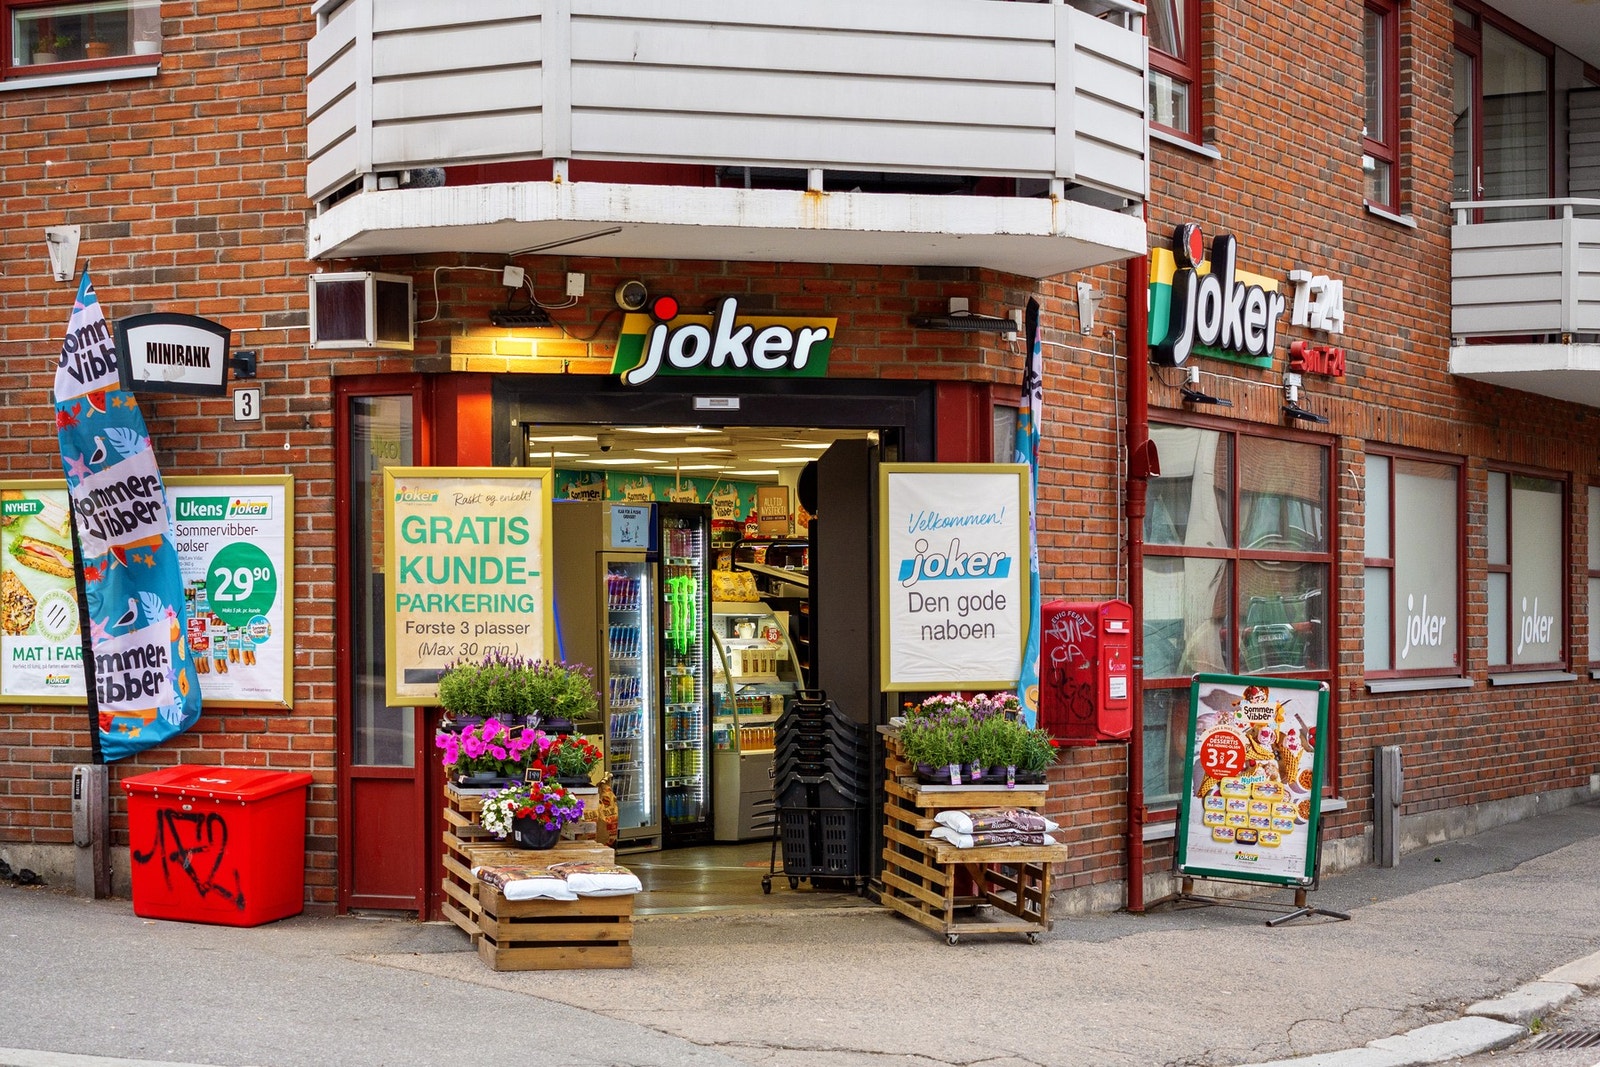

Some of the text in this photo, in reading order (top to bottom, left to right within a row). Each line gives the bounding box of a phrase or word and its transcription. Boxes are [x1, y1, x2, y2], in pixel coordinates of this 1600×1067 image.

[1173, 223, 1286, 367] joker
[625, 295, 830, 386] joker
[146, 341, 211, 368] MINIBANK
[242, 392, 252, 416] 3
[395, 486, 438, 504] joker
[453, 490, 532, 506] Raskt og enkelt!
[5, 502, 37, 512] NYHET!
[180, 499, 267, 518] Ukens joker
[176, 523, 259, 536] Sommervibber-
[401, 515, 530, 545] GRATIS
[908, 506, 1006, 534] Velkommen!
[176, 539, 209, 552] pølser
[400, 556, 540, 584] KUNDE-
[902, 538, 1007, 588] joker
[396, 594, 534, 613] PARKERING
[908, 589, 1007, 617] Den gode
[405, 621, 531, 637] Første 3 plasser
[768, 632, 778, 641] 30
[921, 619, 995, 641] naboen
[1401, 593, 1446, 660] joker
[1517, 596, 1554, 656] joker
[13, 647, 43, 660] MAT
[48, 647, 52, 660] I
[418, 643, 519, 657] (Max 30 min.)
[1206, 748, 1218, 767] 3
[1226, 749, 1238, 769] 2
[1241, 775, 1264, 785] Nyhet!
